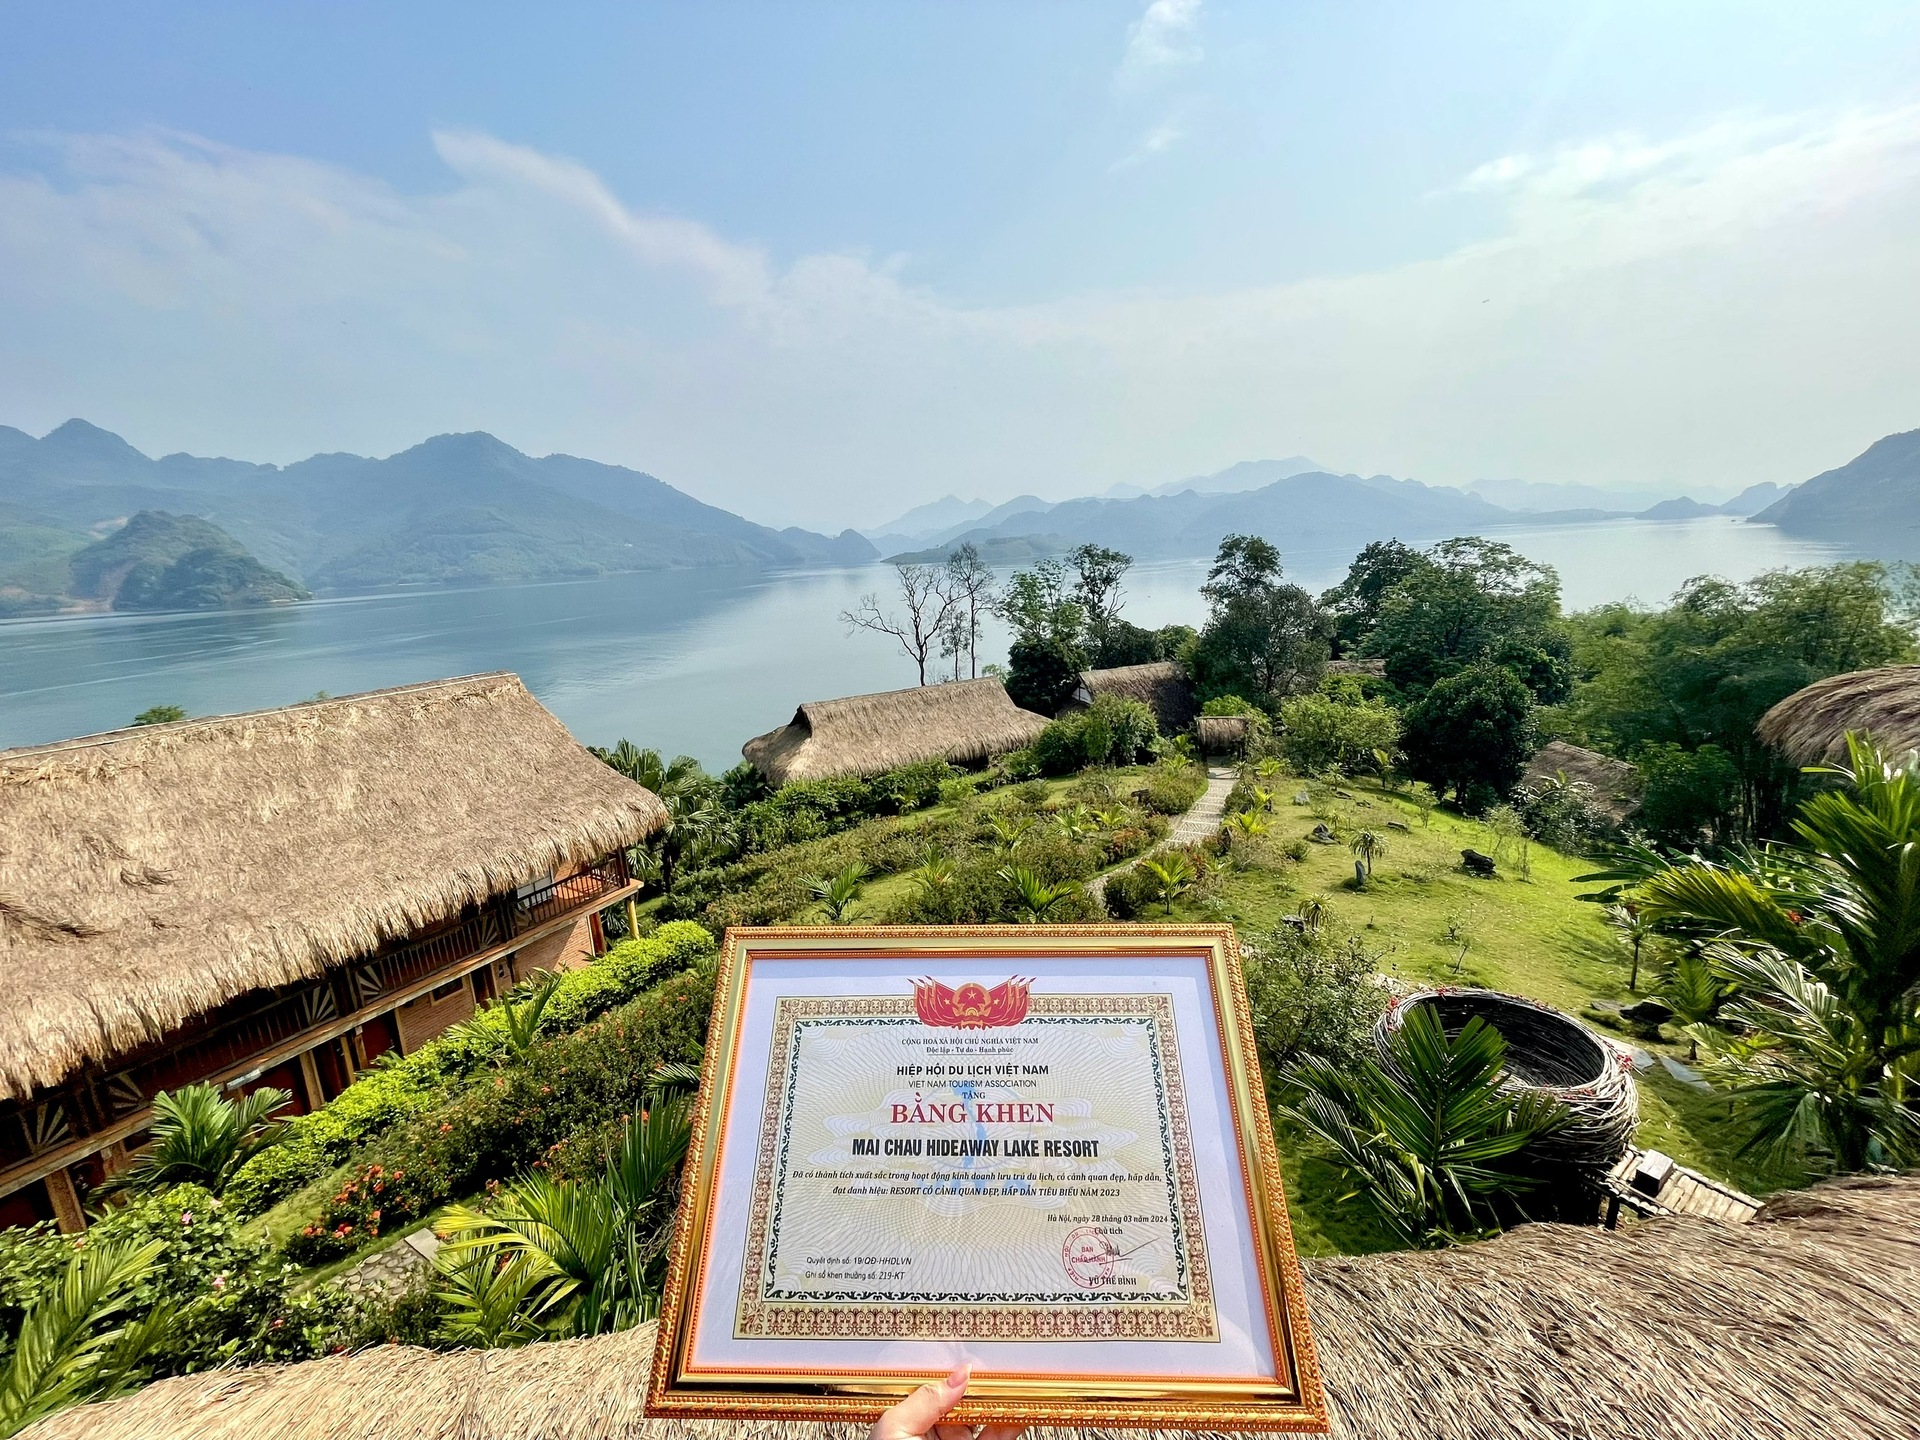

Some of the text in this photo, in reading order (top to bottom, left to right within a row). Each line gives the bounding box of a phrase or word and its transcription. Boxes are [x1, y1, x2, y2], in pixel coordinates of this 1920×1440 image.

[901, 1037, 921, 1046] CỘNG
[896, 1062, 1049, 1077] HIỆP HỘI DU LỊCH VIỆT NAM
[908, 1080, 1037, 1088] VIET NAM TOURISM ASSOCIATION
[890, 1092, 1055, 1124] BẰNG KHEN
[852, 1138, 1100, 1158] MAI CHAU HIDEAWAY LAKE RESORT
[805, 1170, 814, 1178] có
[839, 1170, 854, 1179] tích
[855, 1170, 873, 1179] xuất
[888, 1172, 910, 1181] trong
[911, 1171, 930, 1181] hoạt
[930, 1171, 950, 1182] động
[952, 1172, 969, 1180] kinh
[971, 1172, 995, 1180] doanh
[997, 1172, 1011, 1180] lưu
[1013, 1172, 1025, 1180] trú
[1027, 1172, 1037, 1180] du
[1039, 1172, 1055, 1182] lịch,
[1056, 1172, 1065, 1180] có
[1087, 1174, 1108, 1182] quan
[1109, 1173, 1126, 1183] đẹp,
[1127, 1173, 1143, 1183] hấp
[832, 1186, 846, 1195] đạt
[847, 1186, 867, 1194] danh
[890, 1187, 921, 1195] RESORT
[922, 1185, 933, 1195] CÓ
[934, 1185, 957, 1195] CẢNH
[958, 1188, 981, 1197] QUAN
[982, 1188, 1000, 1197] ĐẸP,
[1001, 1185, 1018, 1195] HẤP
[1020, 1185, 1037, 1195] DẪN
[1039, 1187, 1057, 1196] TIÊU
[1100, 1188, 1120, 1197] 2023
[1047, 1214, 1057, 1222] Hà
[1073, 1215, 1090, 1224] ngày
[1101, 1215, 1122, 1224] tháng
[1150, 1215, 1168, 1223] 2024
[805, 1270, 817, 1279] Ghi
[827, 1271, 843, 1279] khen
[878, 1271, 906, 1280] 219-KT
